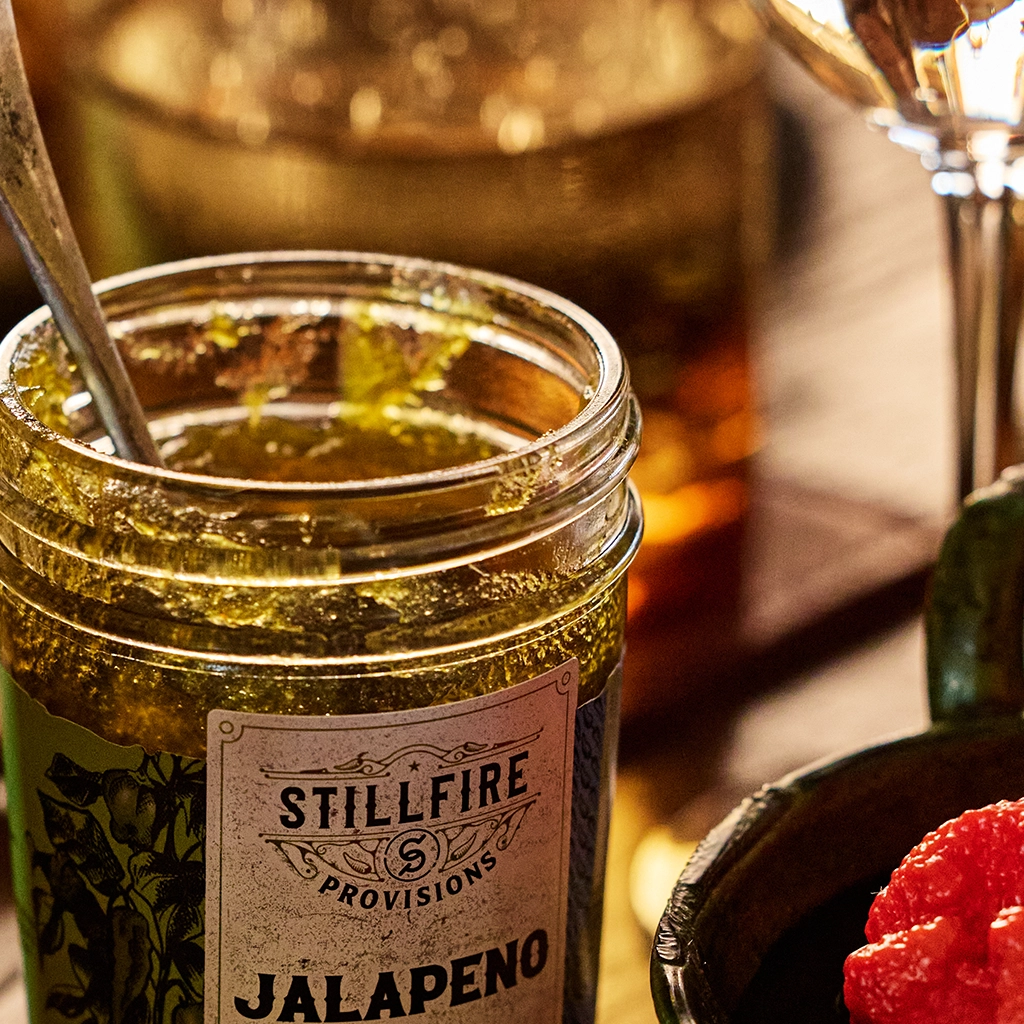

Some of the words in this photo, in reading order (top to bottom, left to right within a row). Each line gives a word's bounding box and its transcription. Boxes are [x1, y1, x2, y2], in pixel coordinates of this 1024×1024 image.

[280, 751, 529, 829] STILLFIRE
[318, 851, 497, 910] PROVISIONS
[234, 929, 549, 1023] JALAPENO
